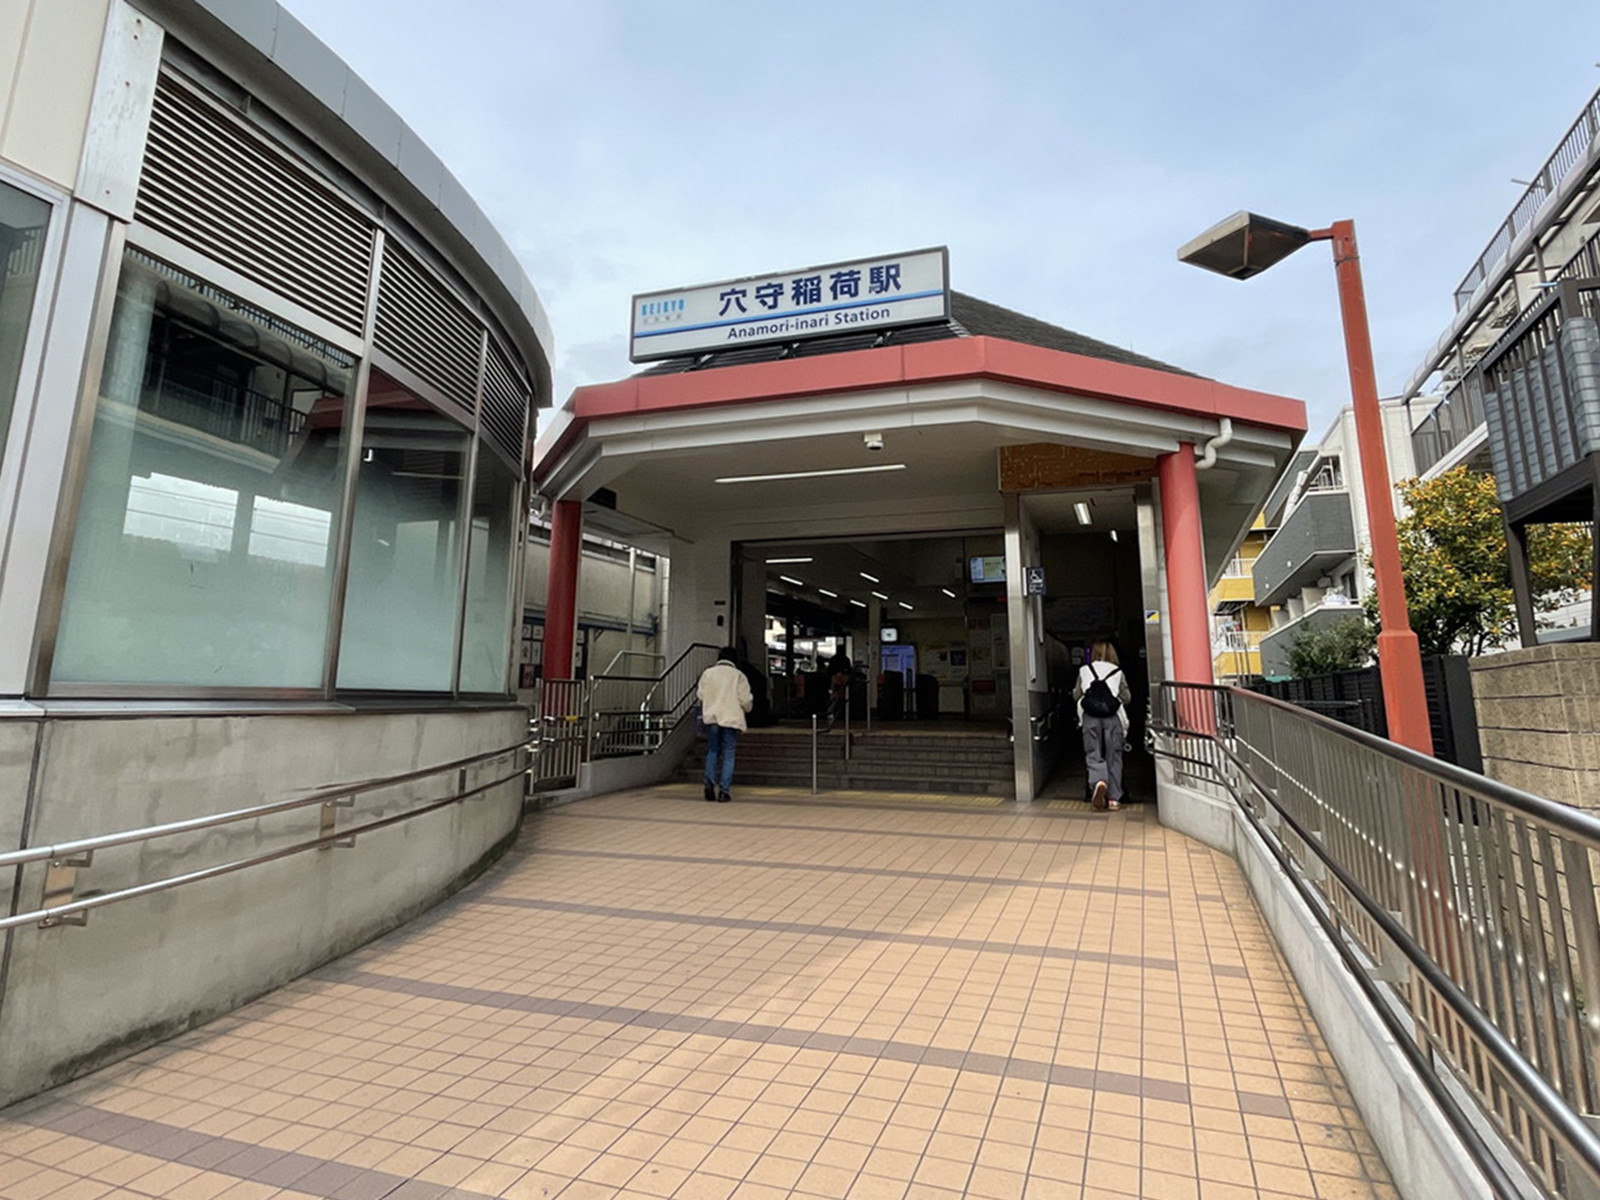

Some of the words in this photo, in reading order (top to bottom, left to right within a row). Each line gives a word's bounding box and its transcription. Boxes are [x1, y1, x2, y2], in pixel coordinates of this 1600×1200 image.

[719, 264, 902, 316] 穴守稲荷駅
[642, 299, 685, 316] KEIKYU
[727, 314, 829, 340] Anamori-inari
[834, 307, 891, 326] Station
